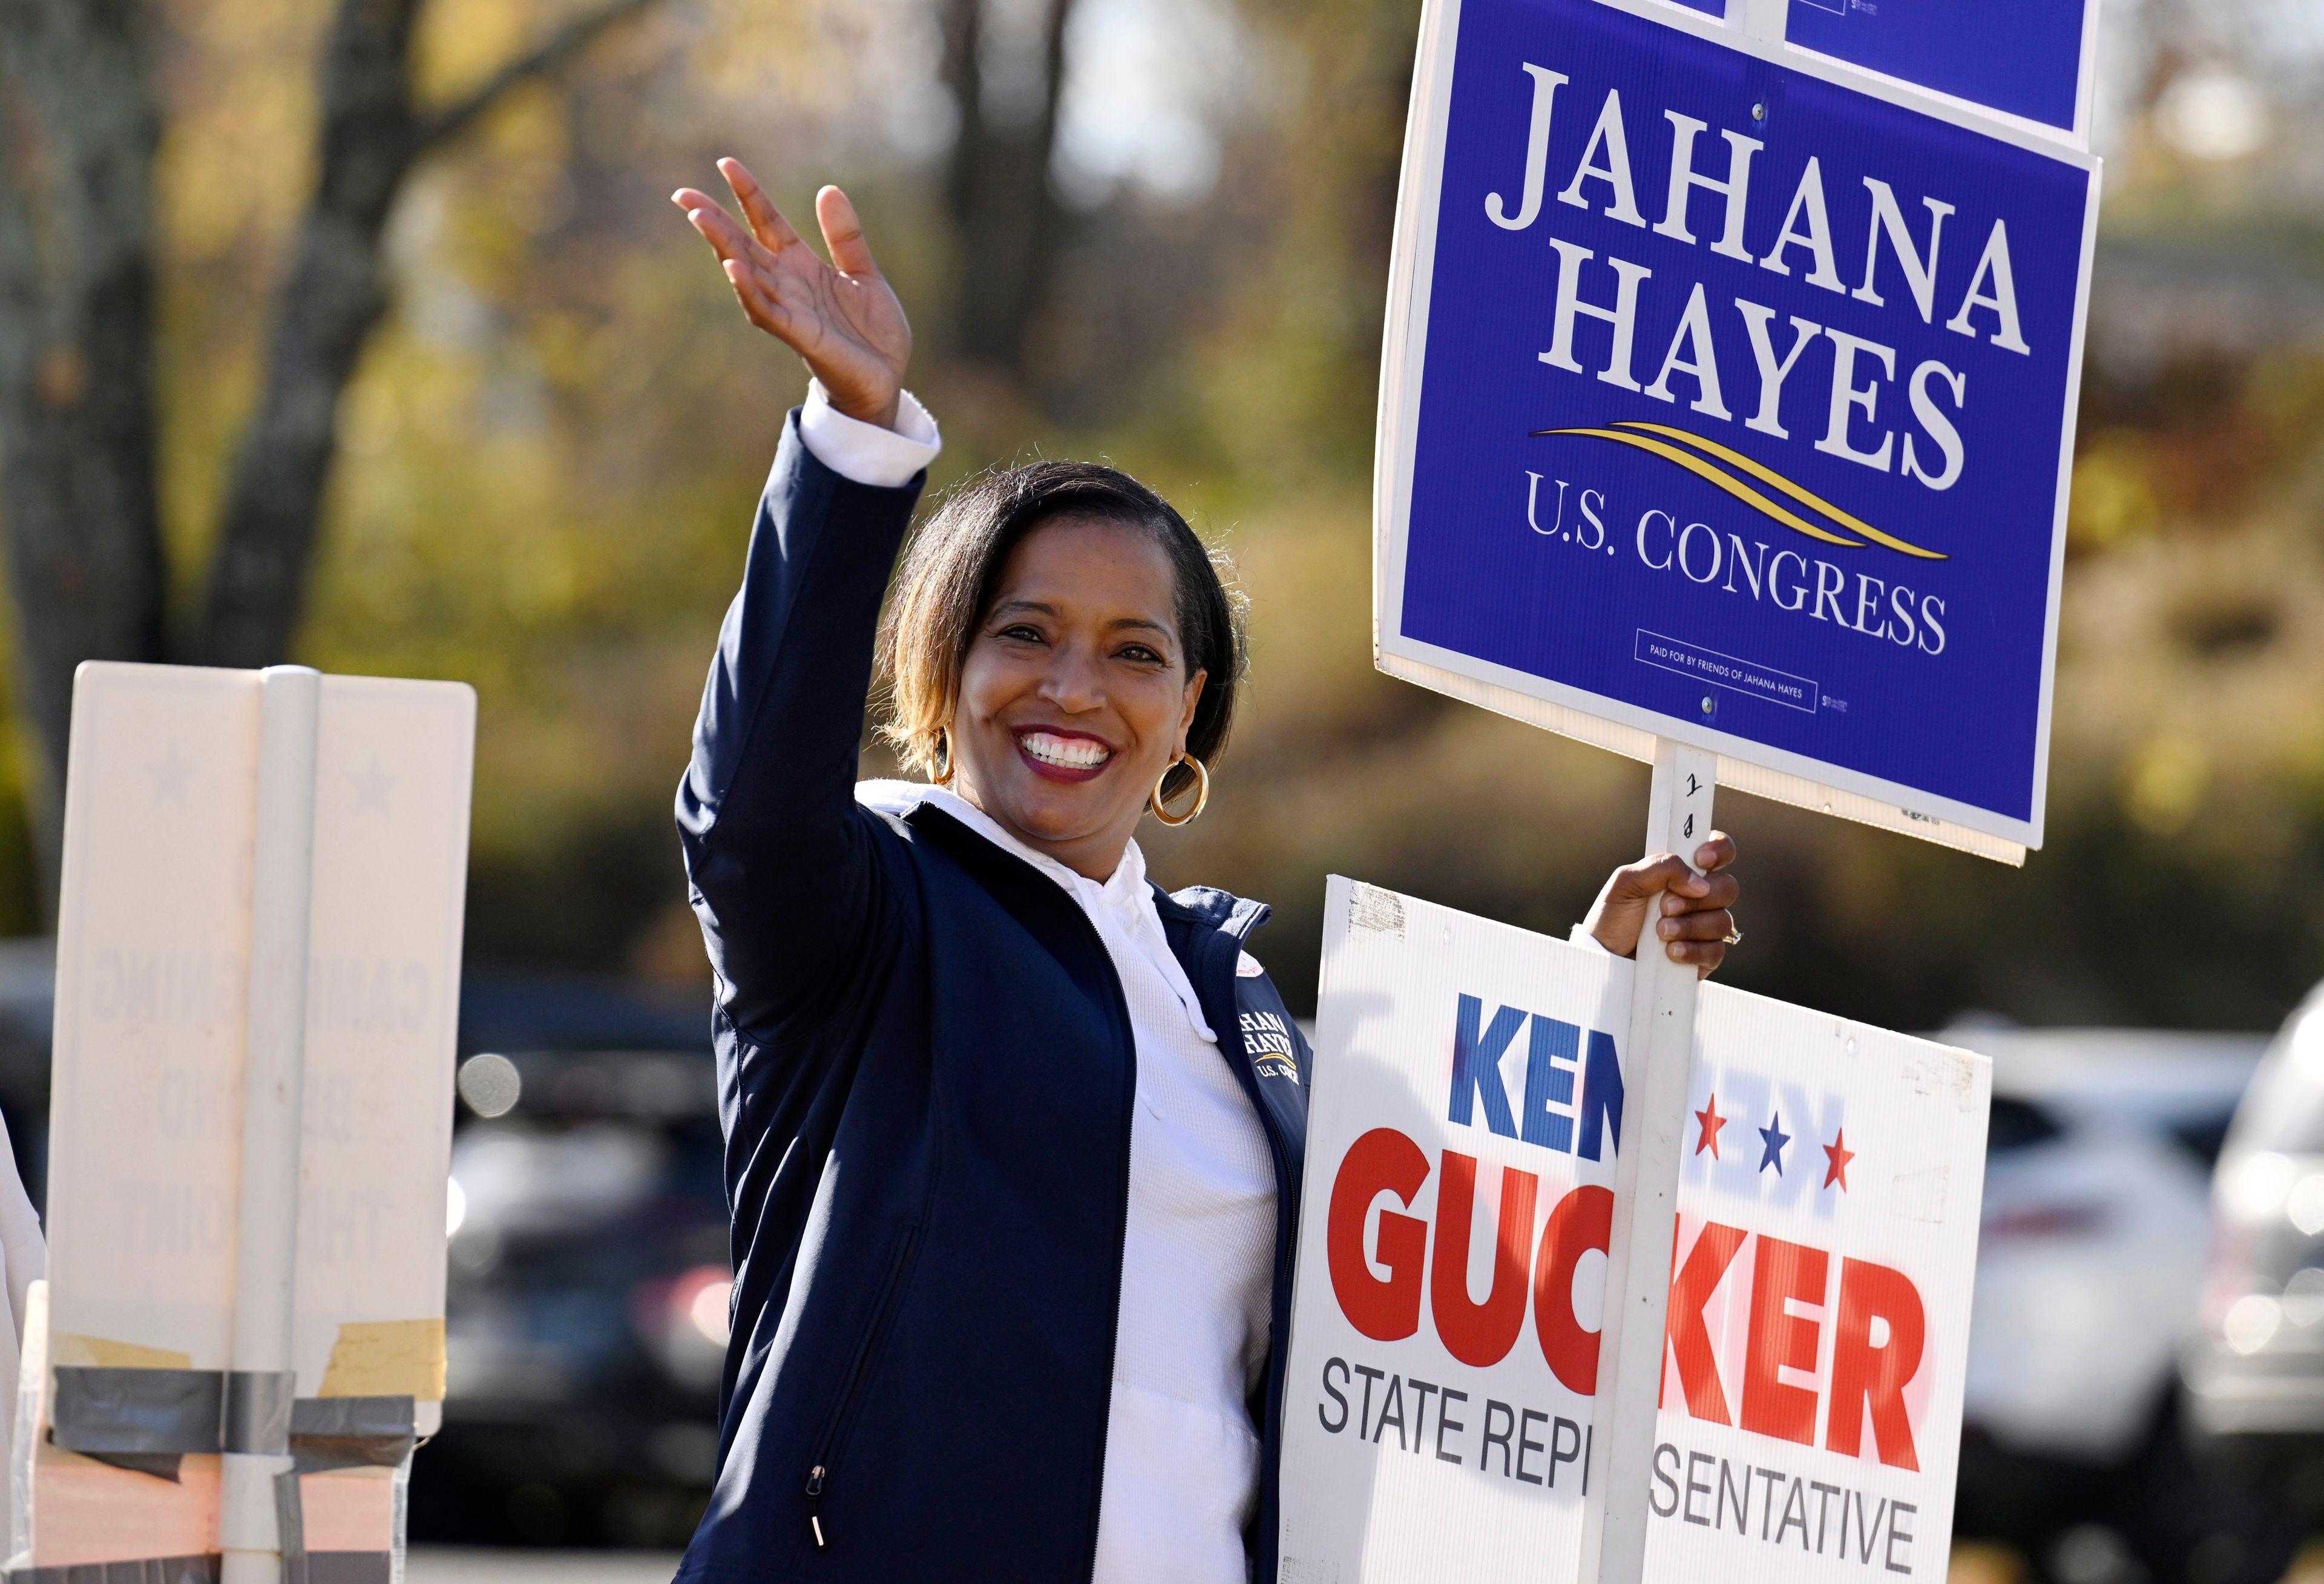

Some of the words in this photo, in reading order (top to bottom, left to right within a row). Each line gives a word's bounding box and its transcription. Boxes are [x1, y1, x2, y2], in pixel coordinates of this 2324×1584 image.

[1485, 61, 2030, 356] JAHANA
[1538, 237, 1966, 491] HAYES
[1525, 470, 1615, 556] U.S.
[1636, 510, 1945, 656] CONGRESS
[1650, 644, 1667, 657] PAID
[1670, 651, 1684, 663] FOR
[1687, 656, 1696, 666] BY
[1698, 659, 1729, 677] FRIENDS
[1731, 669, 1742, 680] OF
[1744, 673, 1776, 691] JAHANA
[1778, 683, 1802, 699] HAYES
[1318, 1356, 1468, 1465] STATE
